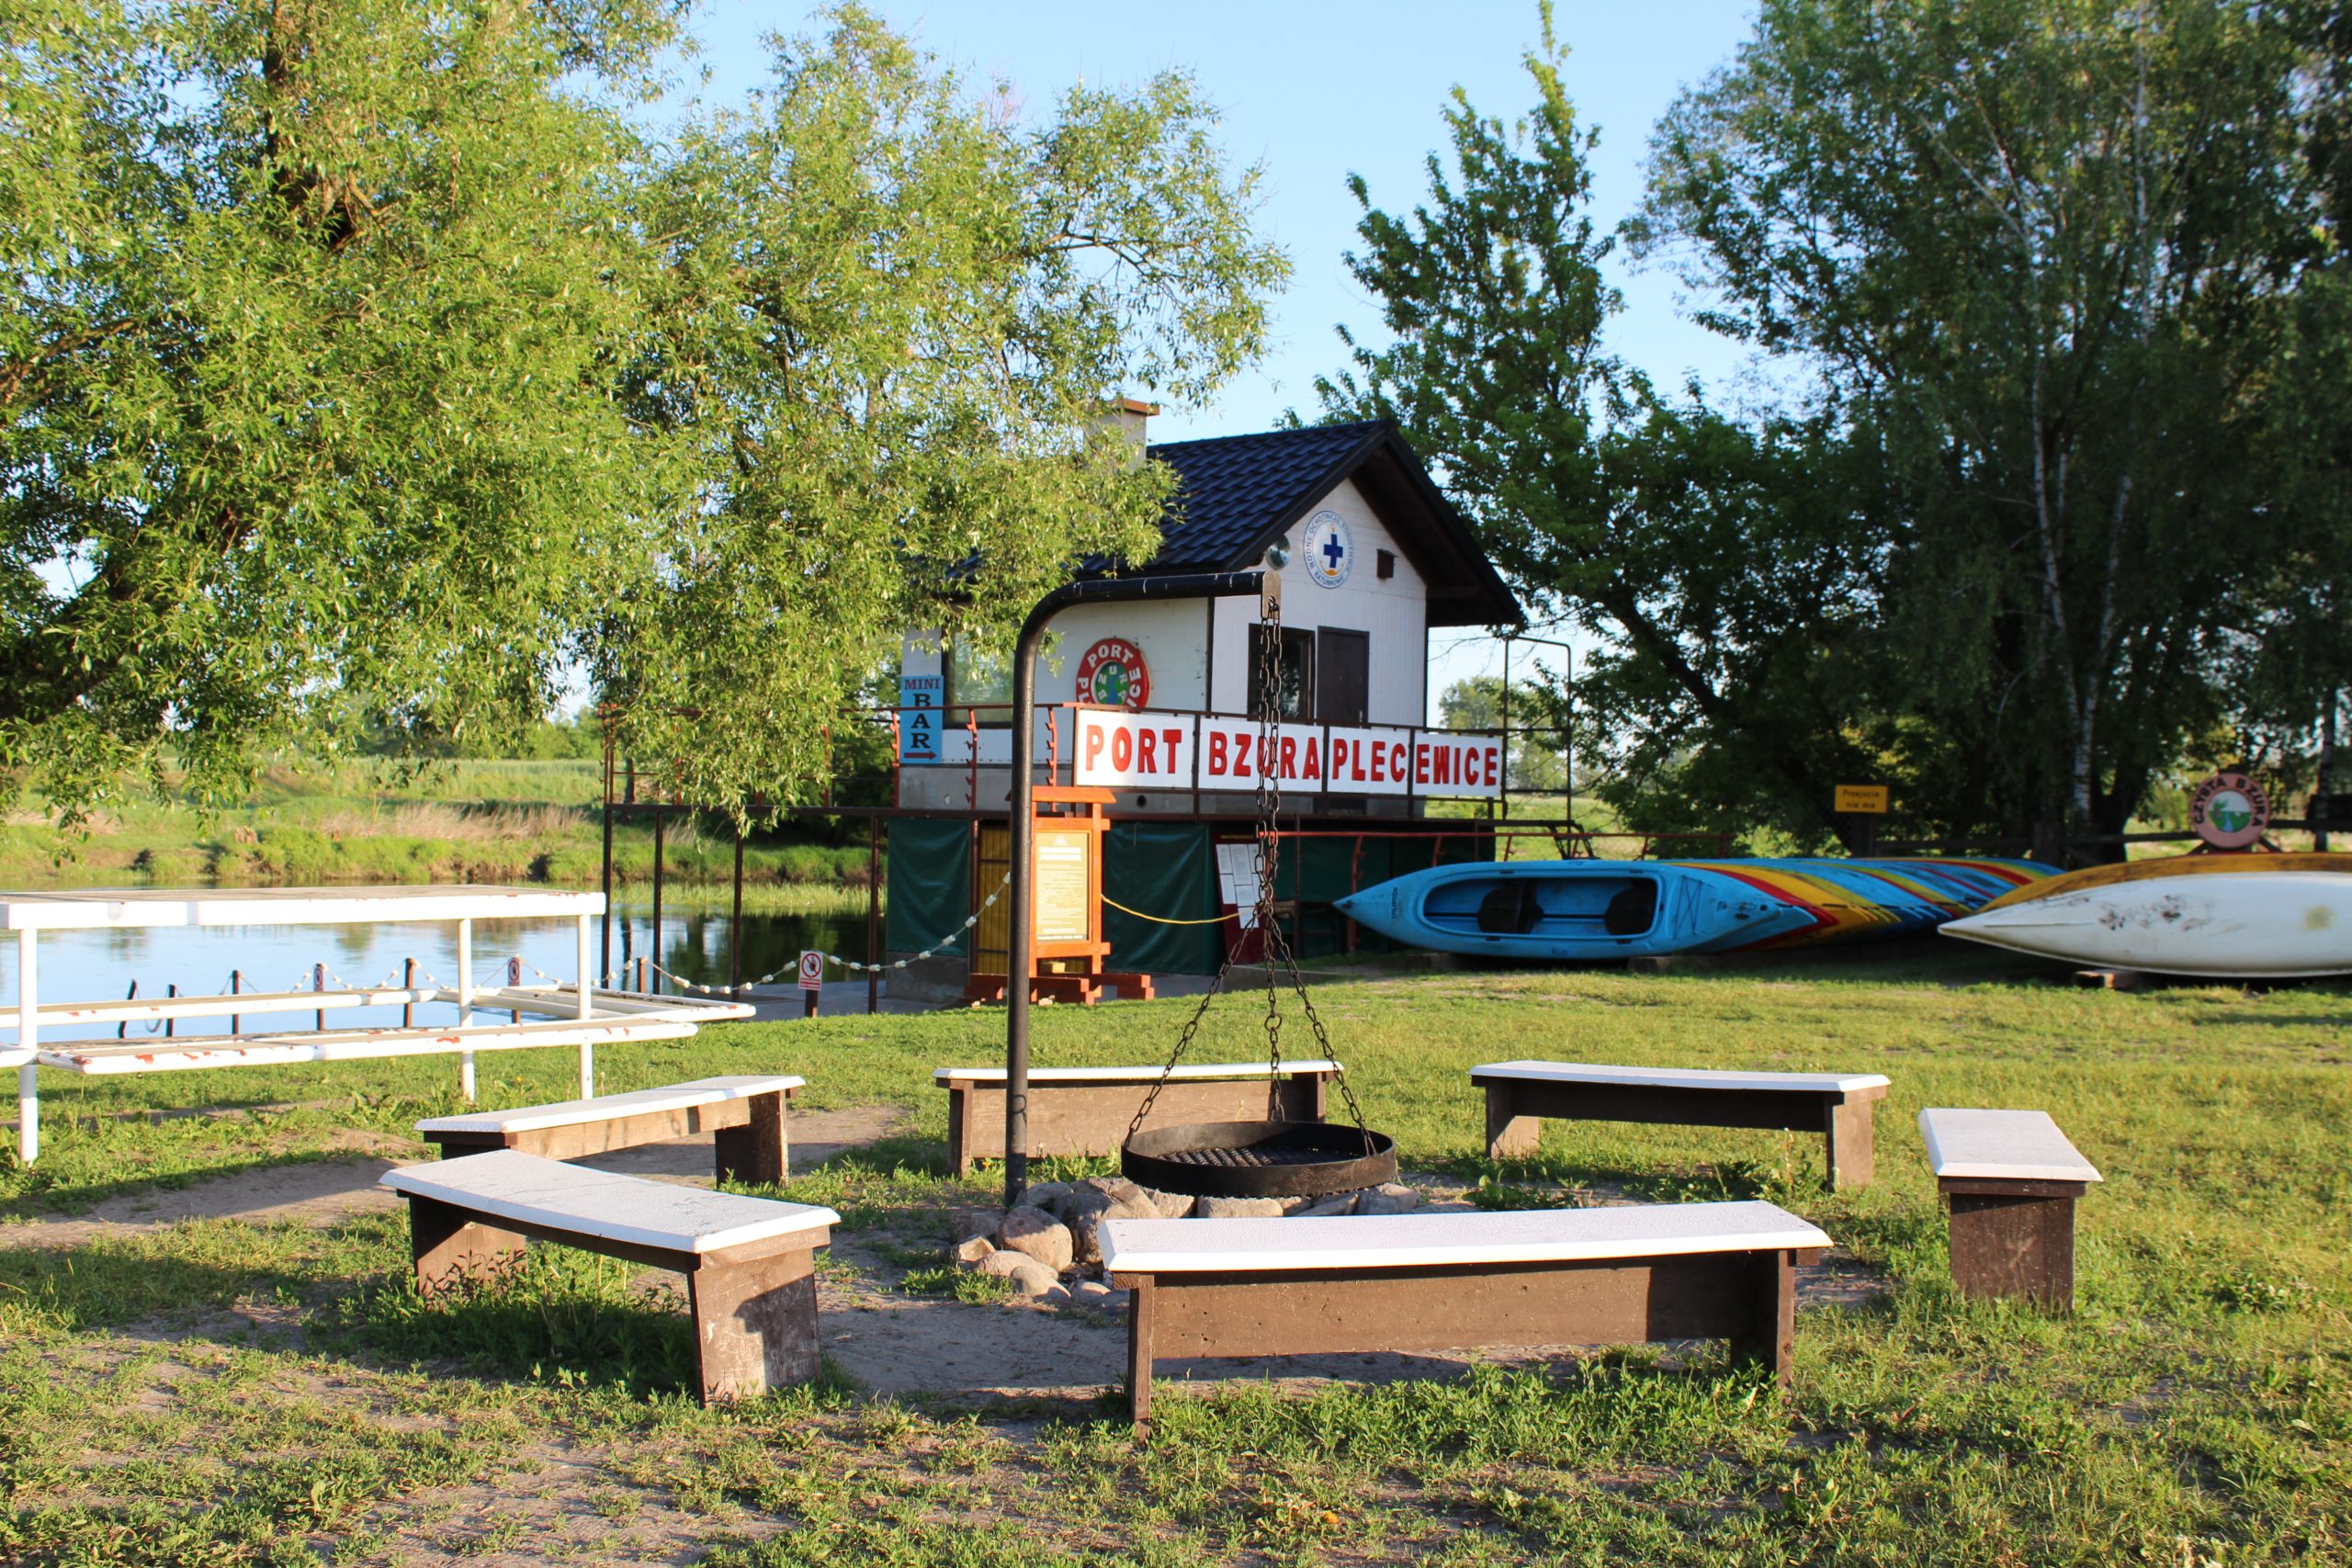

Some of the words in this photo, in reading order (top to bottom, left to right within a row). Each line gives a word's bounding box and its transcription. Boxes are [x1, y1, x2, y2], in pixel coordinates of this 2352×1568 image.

[1088, 644, 1134, 669] PORT
[904, 678, 940, 690] MINI
[1098, 665, 1128, 701] BZURA
[910, 693, 932, 749] BAR
[1086, 724, 1182, 773] PORT
[1208, 731, 1320, 780] BZURA
[1332, 738, 1498, 786] PLECEWICE
[2194, 777, 2226, 824] CZYSTA
[2235, 777, 2267, 827] BZURA
